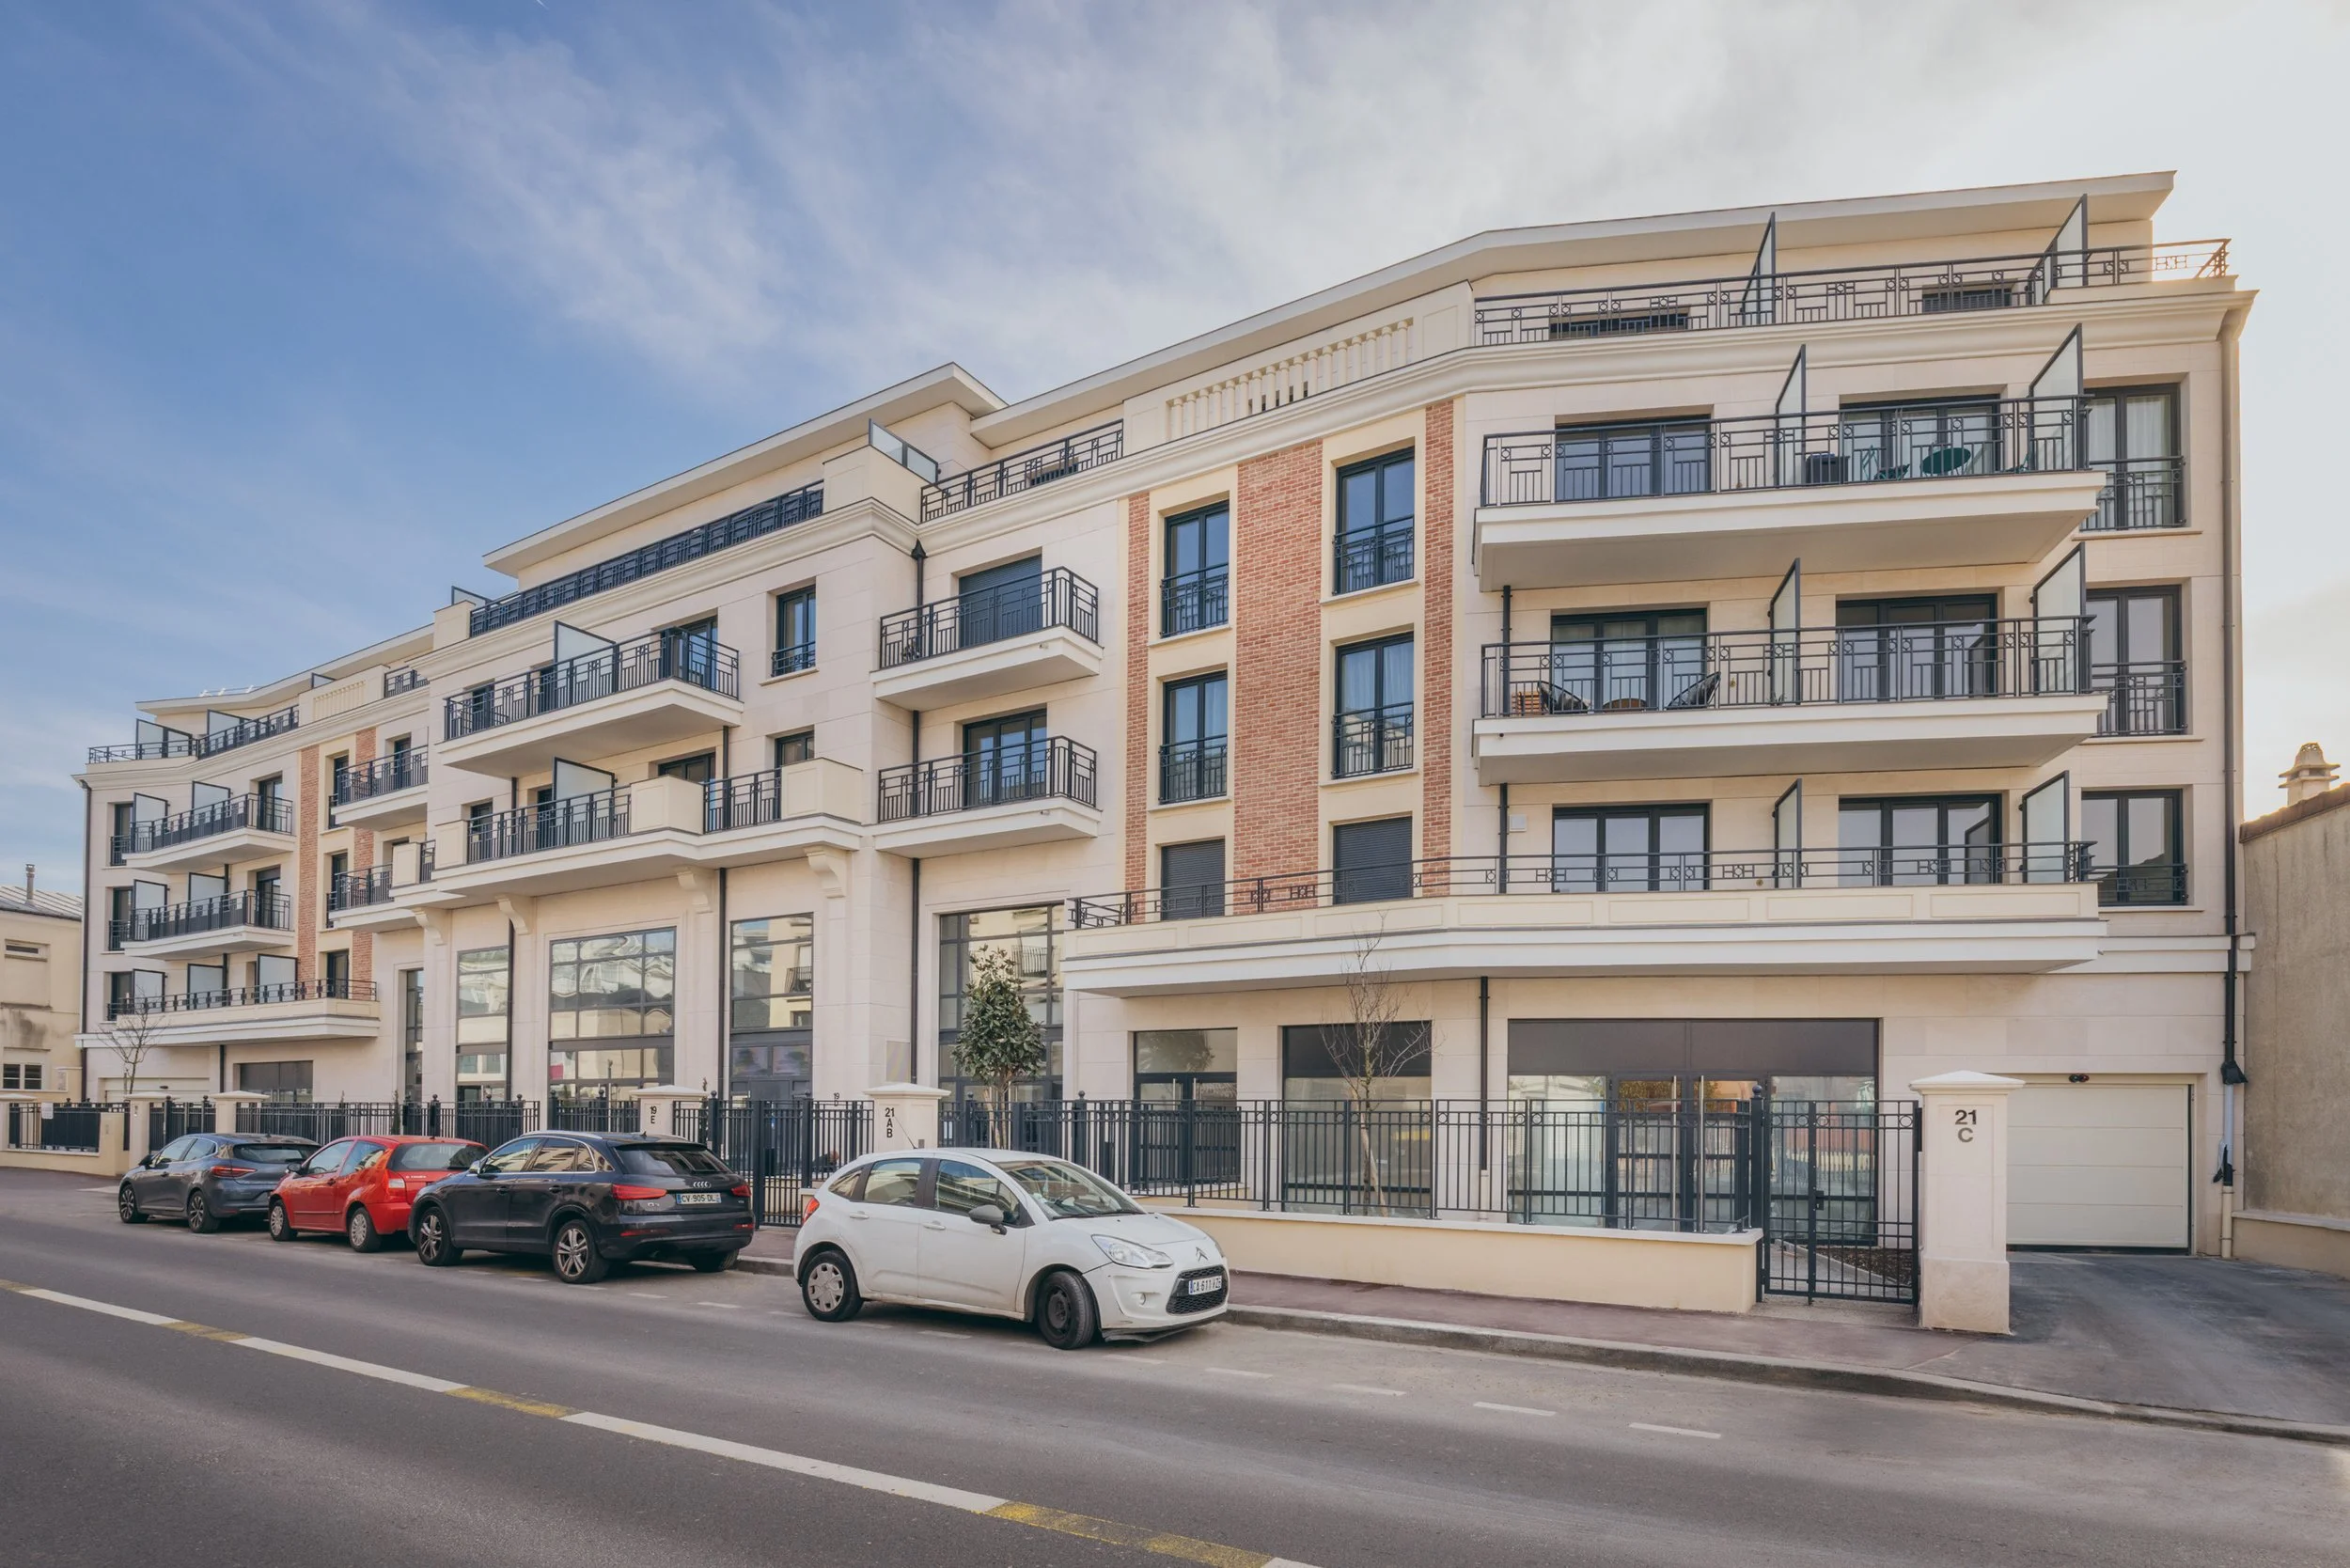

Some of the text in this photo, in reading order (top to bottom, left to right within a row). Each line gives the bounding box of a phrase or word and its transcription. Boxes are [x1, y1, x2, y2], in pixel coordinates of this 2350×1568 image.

[650, 1105, 657, 1114] 19
[885, 1107, 895, 1118] 21
[1955, 1109, 1977, 1125] 21
[886, 1118, 893, 1128] A
[886, 1129, 893, 1138] B
[1958, 1127, 1974, 1143] C
